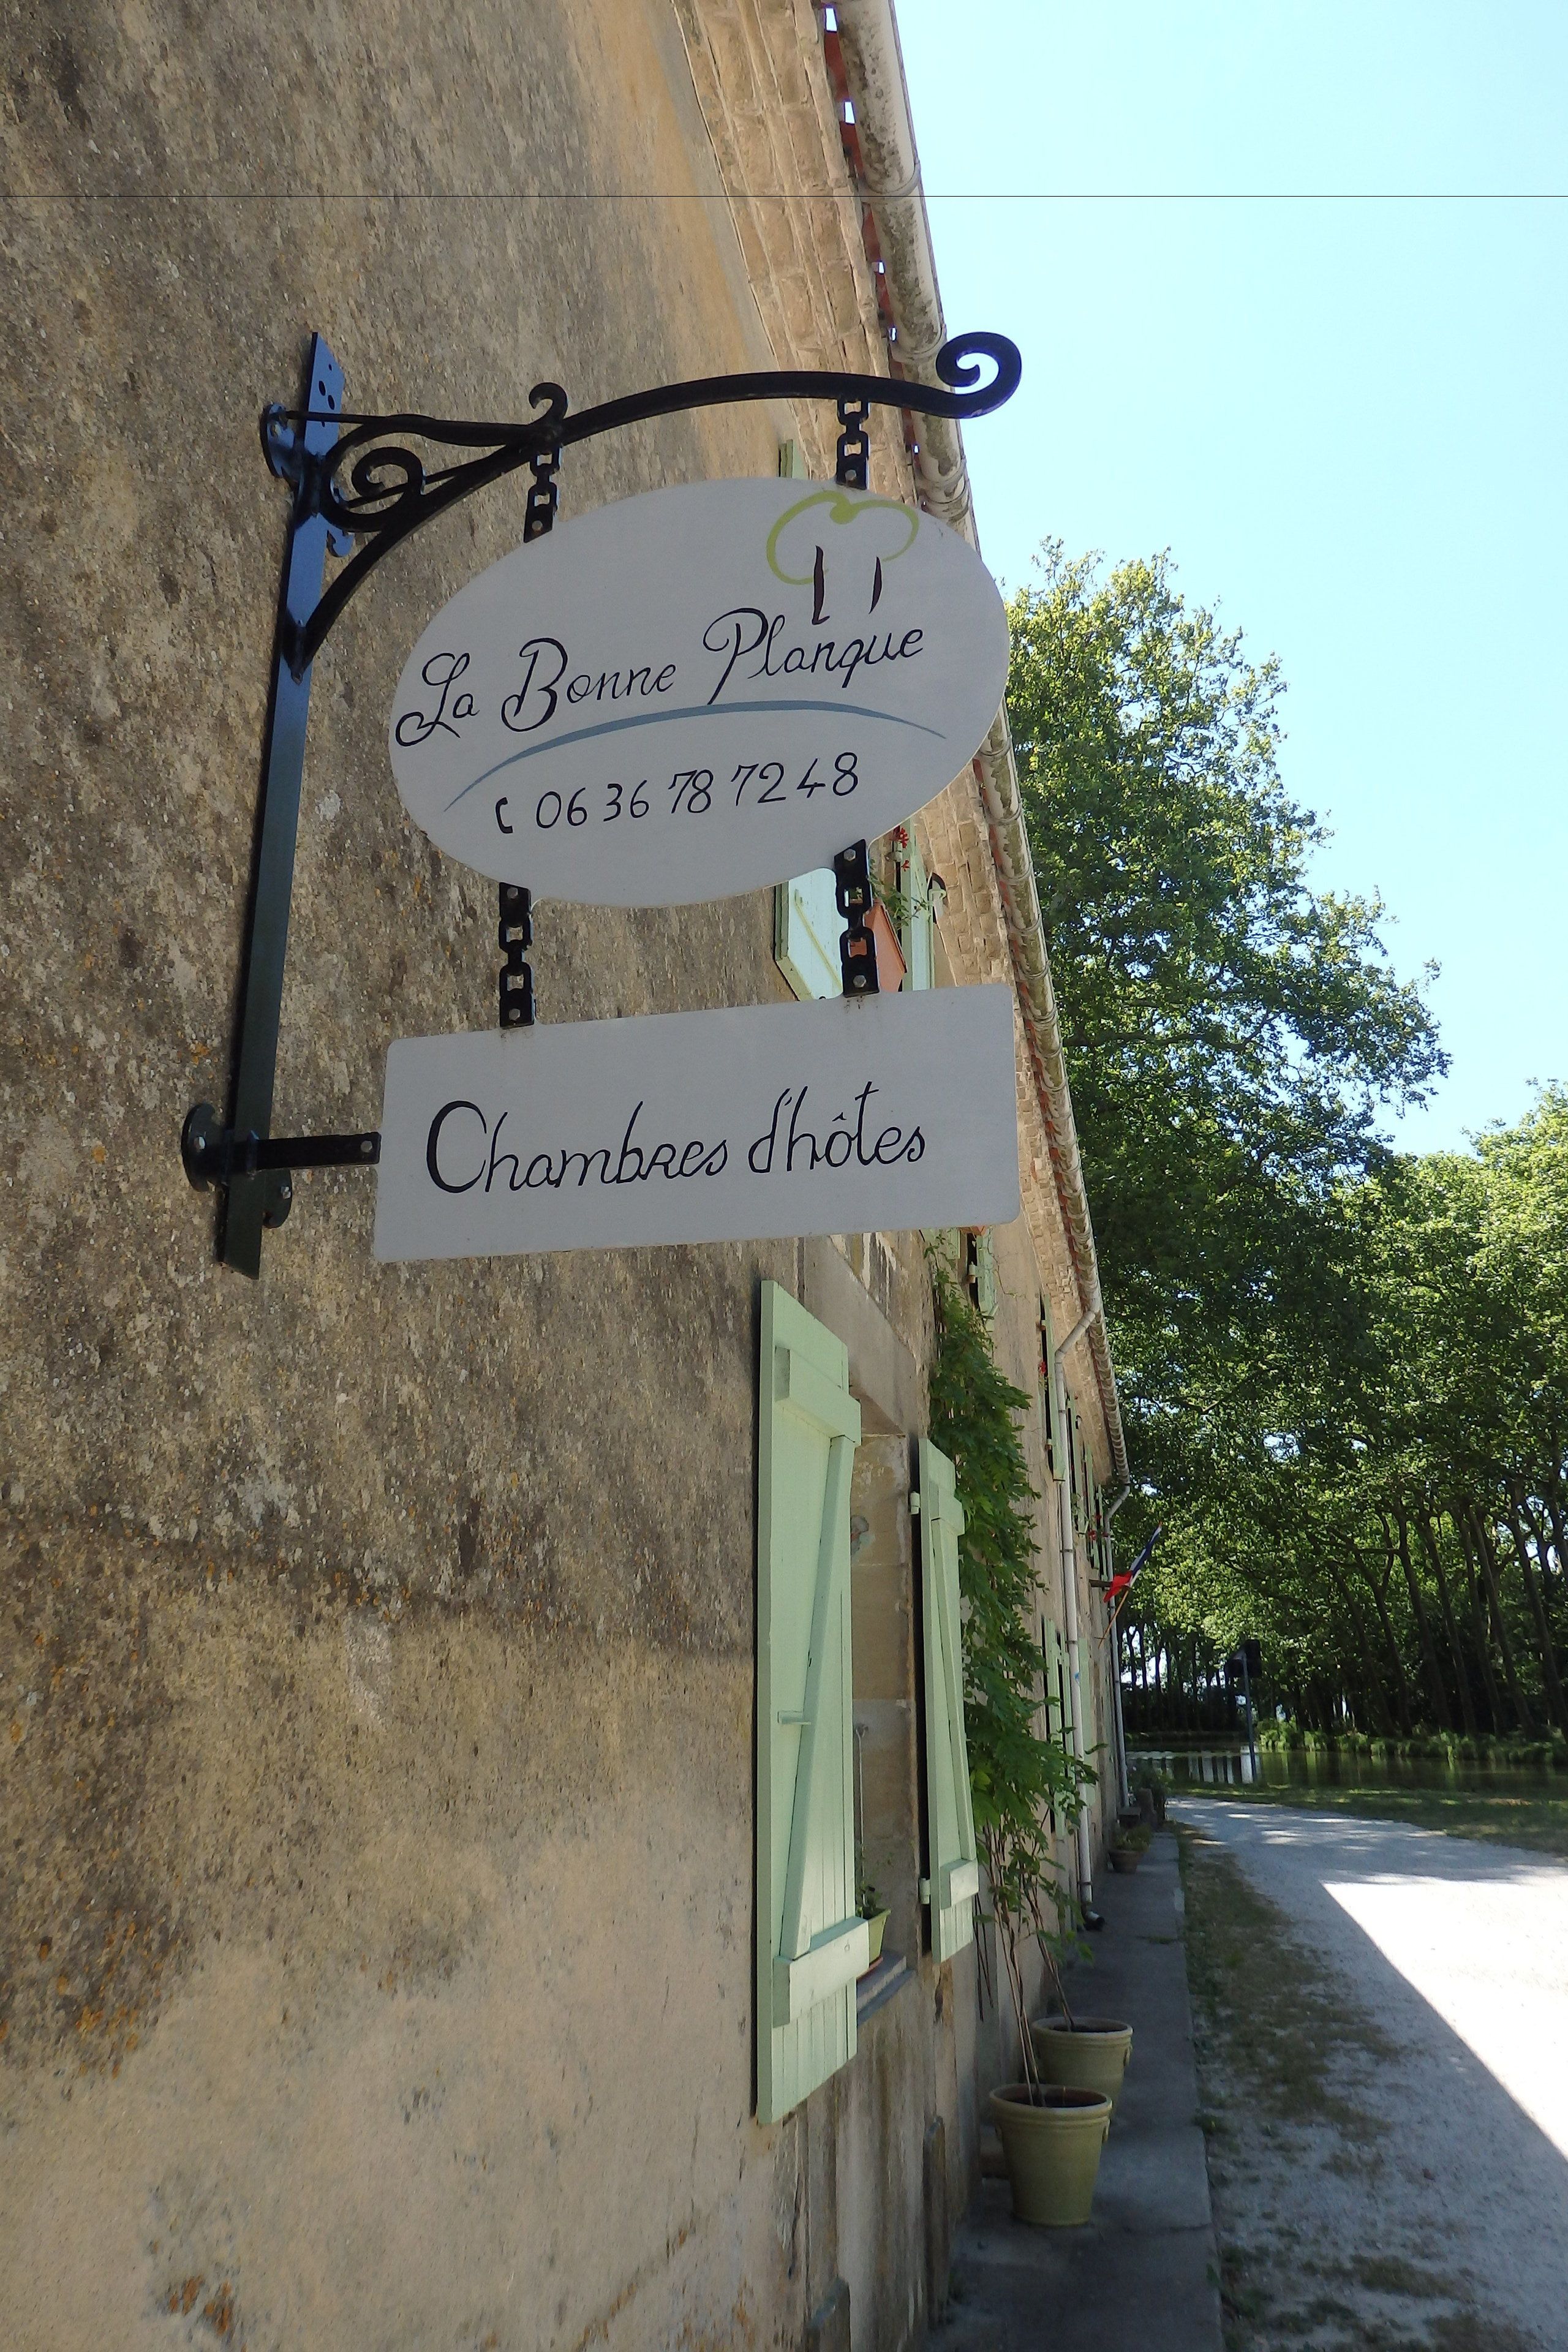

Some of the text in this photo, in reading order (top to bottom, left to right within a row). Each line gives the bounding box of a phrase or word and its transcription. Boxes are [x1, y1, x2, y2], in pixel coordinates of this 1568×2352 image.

[395, 607, 924, 747] La Bonne Planque
[426, 1081, 925, 1194] Chambres d'hôtes
